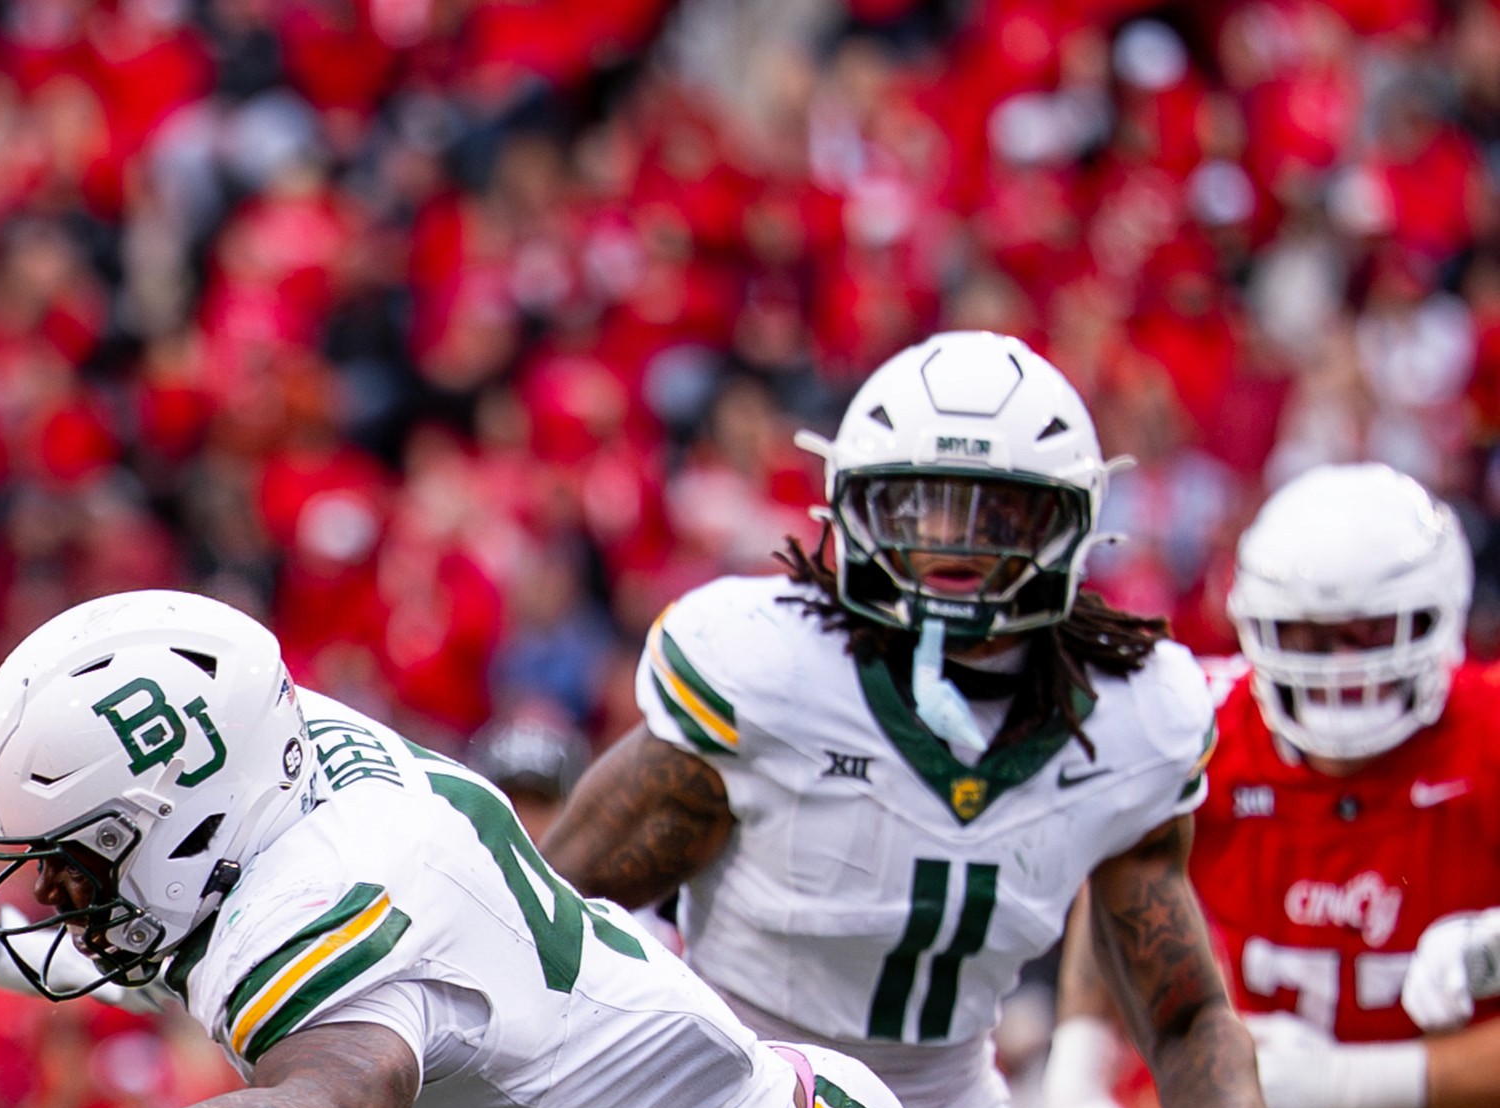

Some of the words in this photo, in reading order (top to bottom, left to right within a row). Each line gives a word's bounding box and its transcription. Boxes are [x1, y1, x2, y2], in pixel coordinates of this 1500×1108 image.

[91, 677, 227, 788] BU
[306, 719, 405, 792] REED
[821, 750, 873, 784] XII
[402, 738, 650, 994] 4
[866, 857, 1000, 1040] 11
